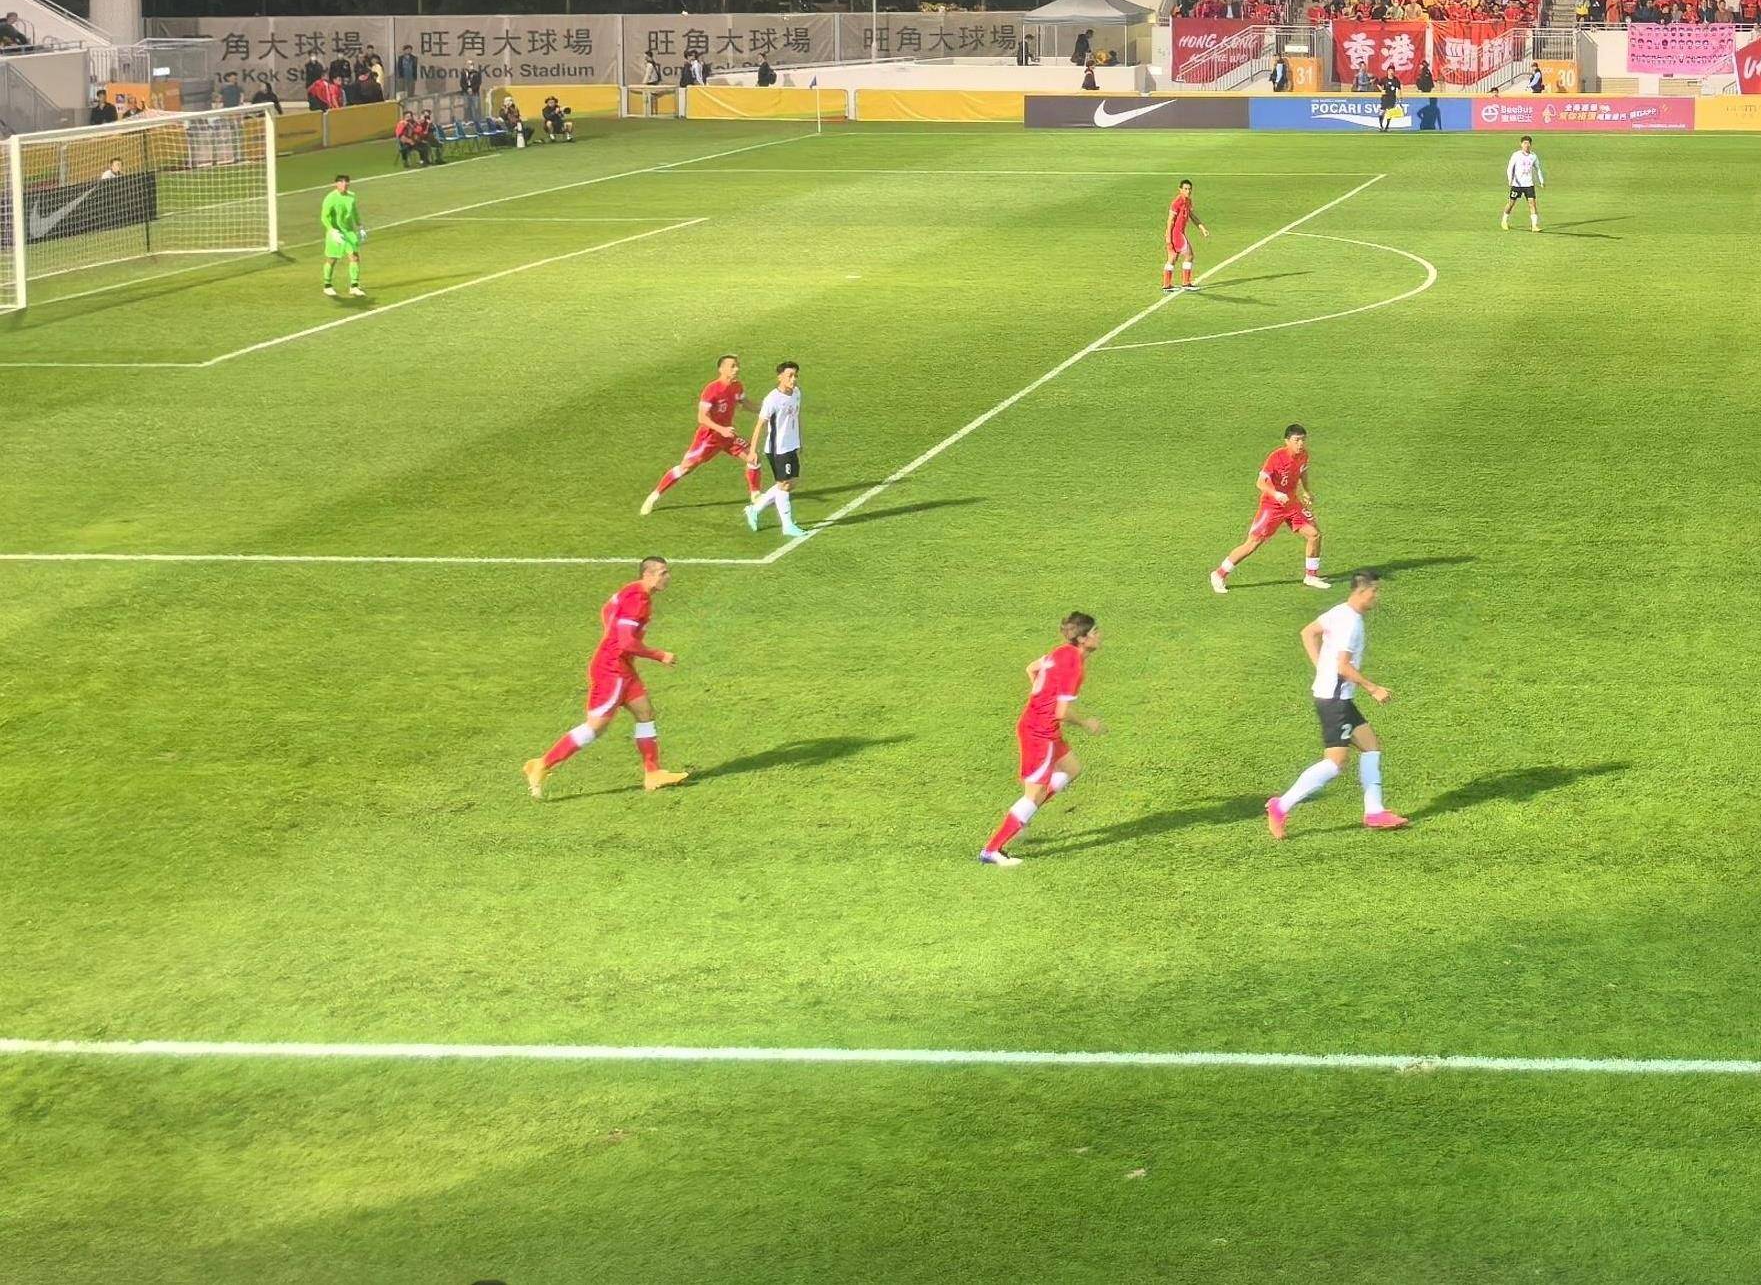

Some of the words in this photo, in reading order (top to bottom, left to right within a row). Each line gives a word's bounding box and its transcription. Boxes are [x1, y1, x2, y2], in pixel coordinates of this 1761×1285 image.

[183, 31, 365, 61] 角大球場
[420, 28, 594, 56] 旺角大球場
[648, 27, 811, 56] 旺角大球場
[1178, 33, 1218, 49] HONG
[1343, 32, 1416, 71] 香港
[519, 63, 595, 79] Stadium
[1295, 66, 1312, 85] 31
[1558, 69, 1576, 87] 30
[1311, 103, 1361, 114] POCARI
[1340, 723, 1353, 740] 2
